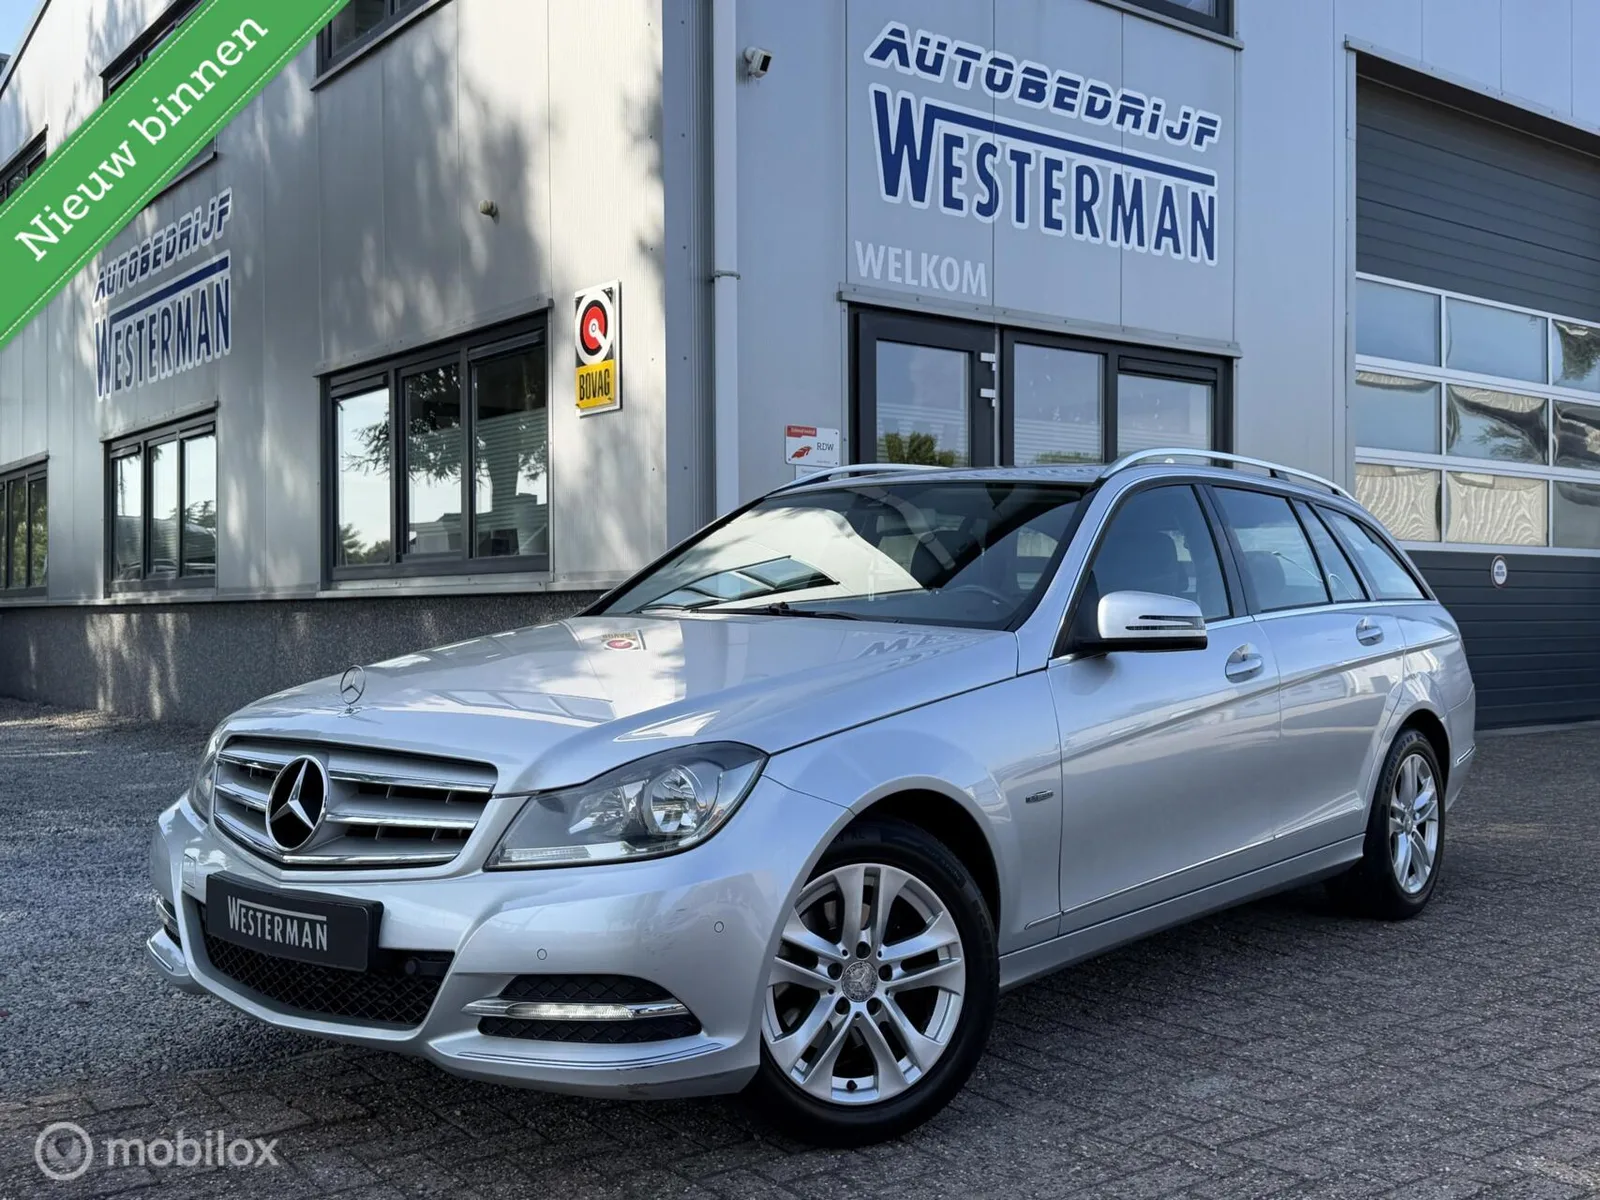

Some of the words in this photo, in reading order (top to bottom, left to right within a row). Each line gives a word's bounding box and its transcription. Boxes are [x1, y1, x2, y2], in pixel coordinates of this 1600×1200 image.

[866, 23, 1220, 149] AUTOBEDRIJF
[871, 86, 1217, 264] WESTERMAN
[94, 188, 232, 305] AUTOBEDRIJF
[855, 240, 988, 297] WELKOM
[95, 252, 231, 400] WESTERMAN
[578, 368, 610, 401] BOVAG
[816, 441, 835, 451] RDW
[227, 895, 328, 952] WESTERMAN
